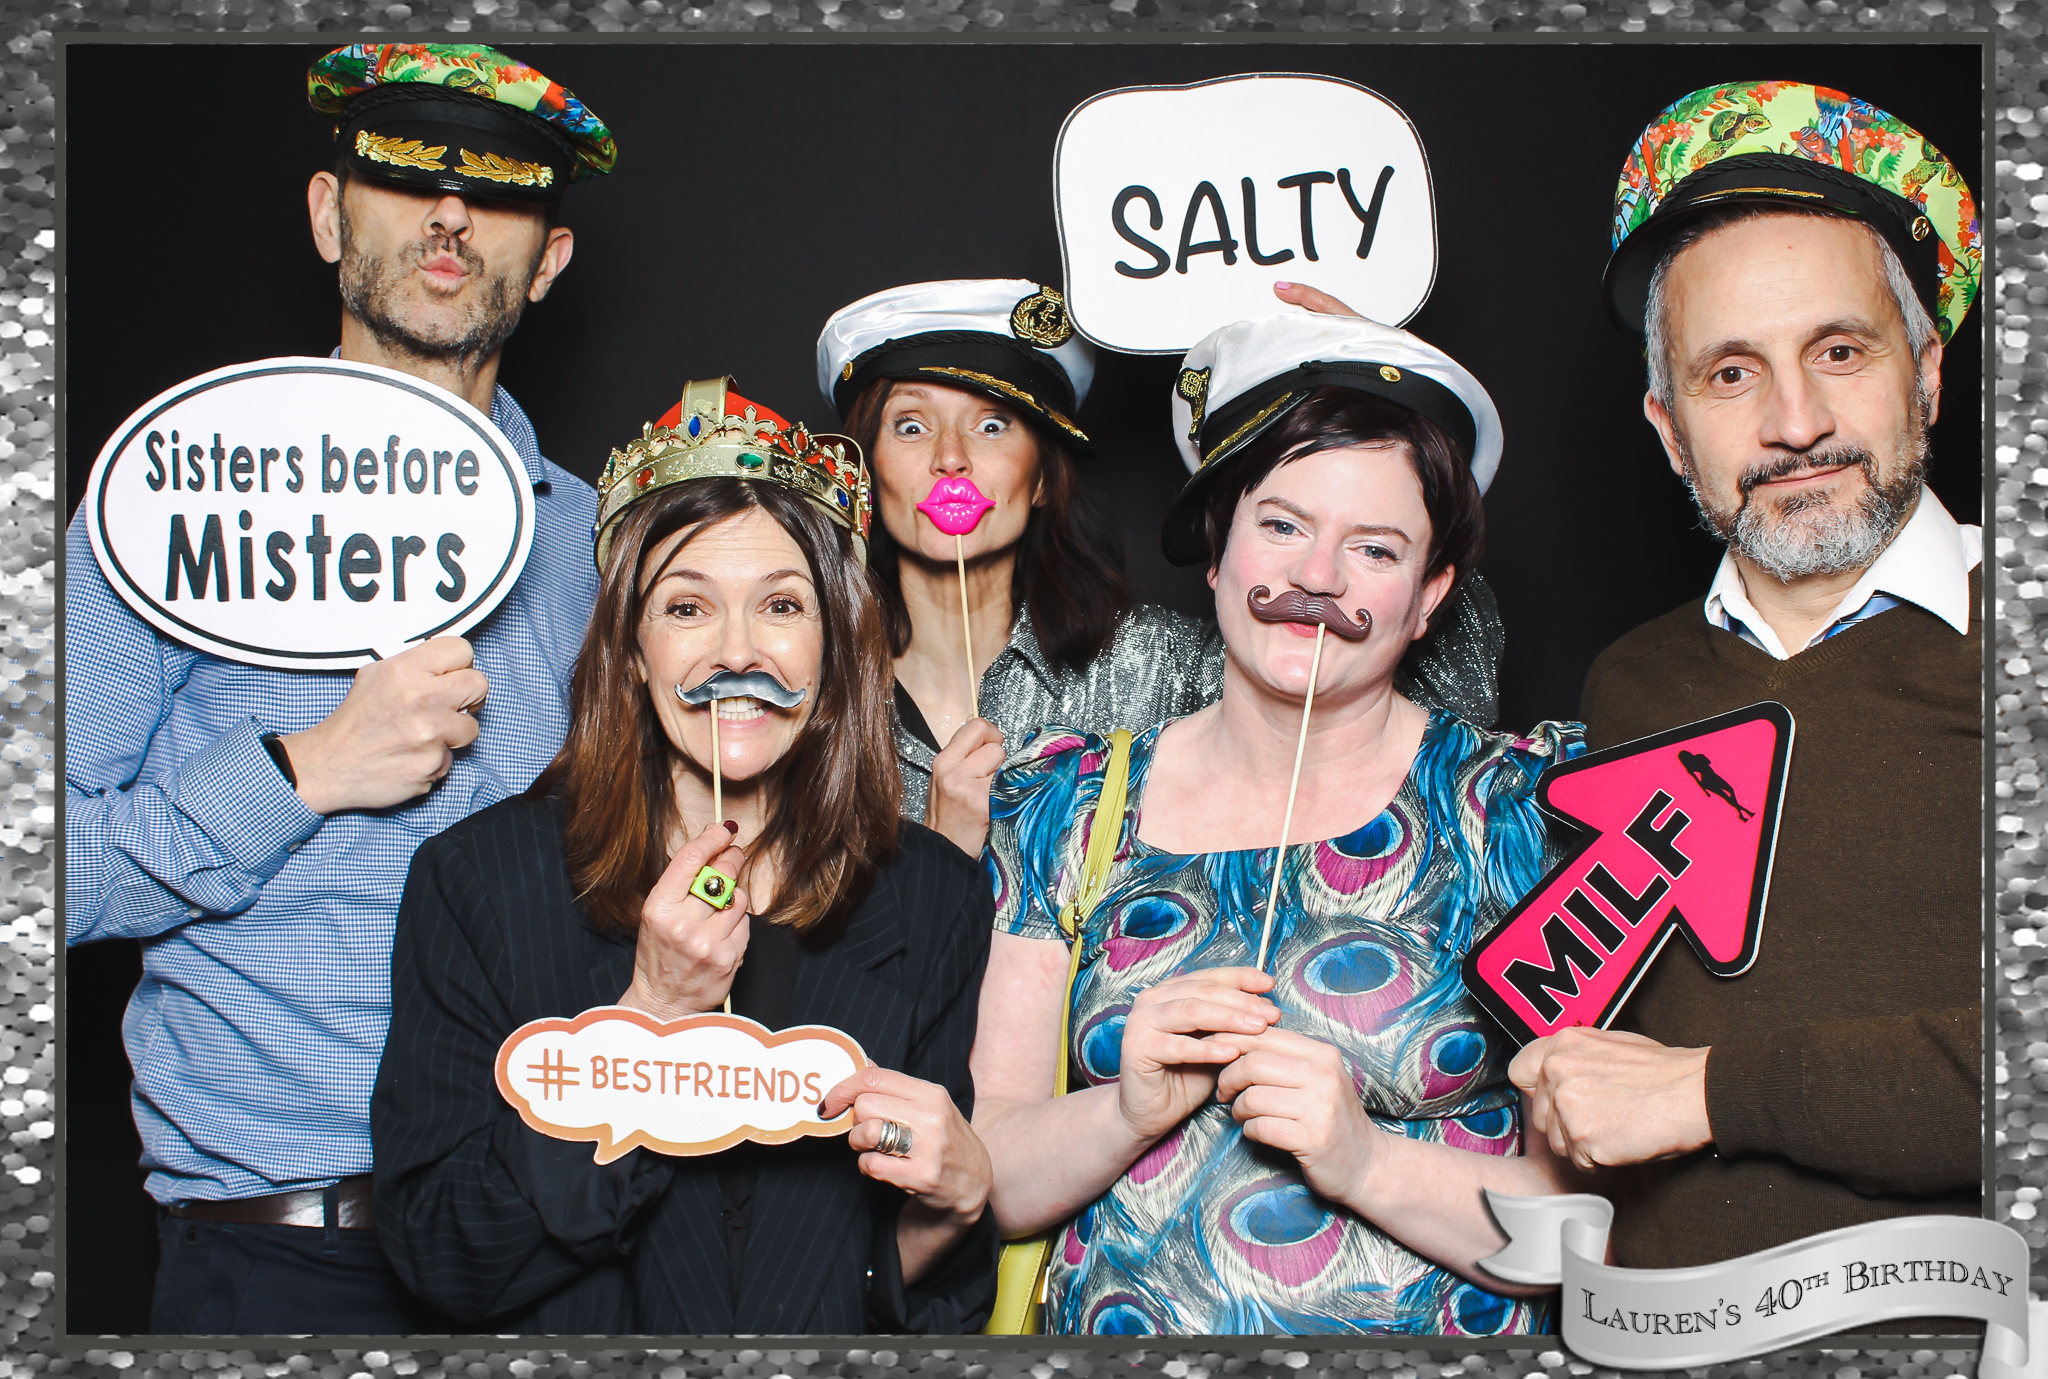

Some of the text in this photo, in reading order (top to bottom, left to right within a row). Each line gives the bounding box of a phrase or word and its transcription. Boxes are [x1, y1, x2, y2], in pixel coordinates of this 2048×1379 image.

[1112, 166, 1394, 279] SALTY
[146, 430, 480, 495] Sisters before
[166, 510, 466, 602] Misters
[1502, 789, 1692, 1026] MILF
